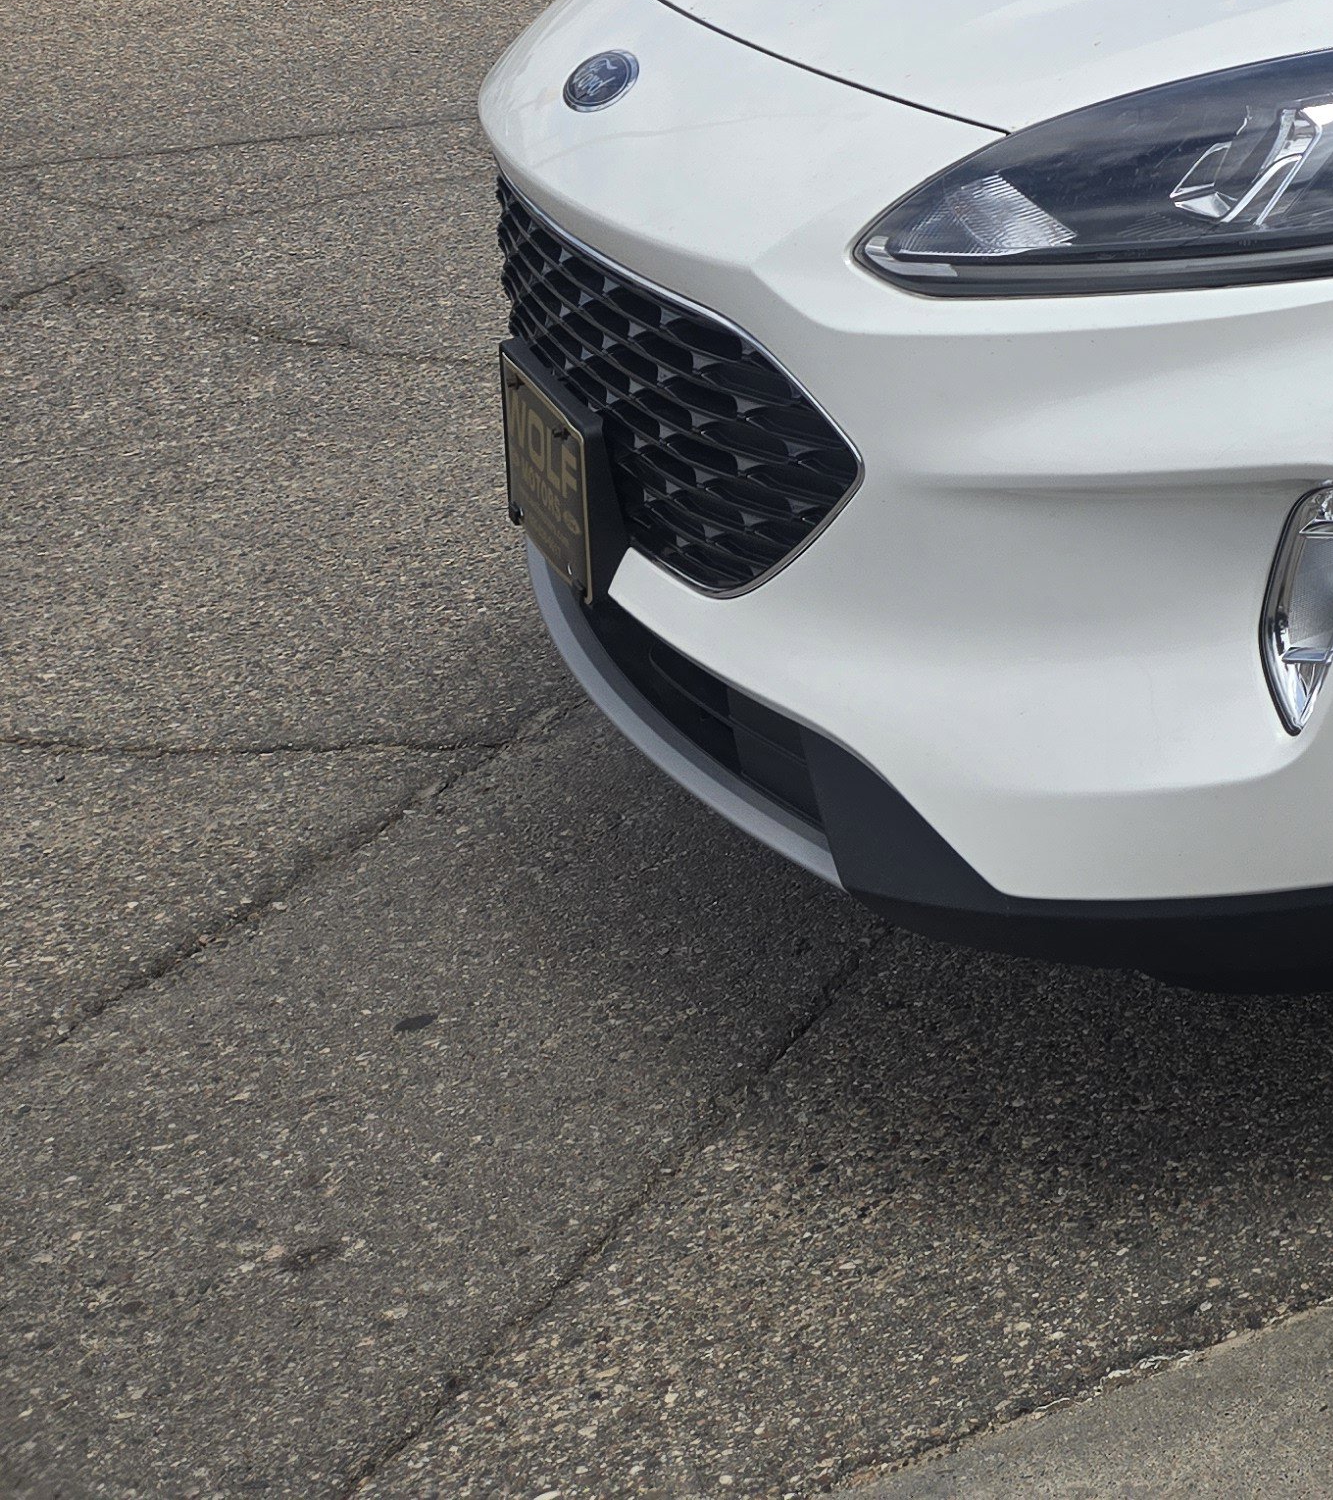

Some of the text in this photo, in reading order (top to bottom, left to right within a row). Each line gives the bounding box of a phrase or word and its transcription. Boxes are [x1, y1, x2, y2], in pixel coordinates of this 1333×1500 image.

[572, 57, 618, 97] Ford
[508, 389, 579, 499] WOLF
[520, 456, 564, 524] MOTORS
